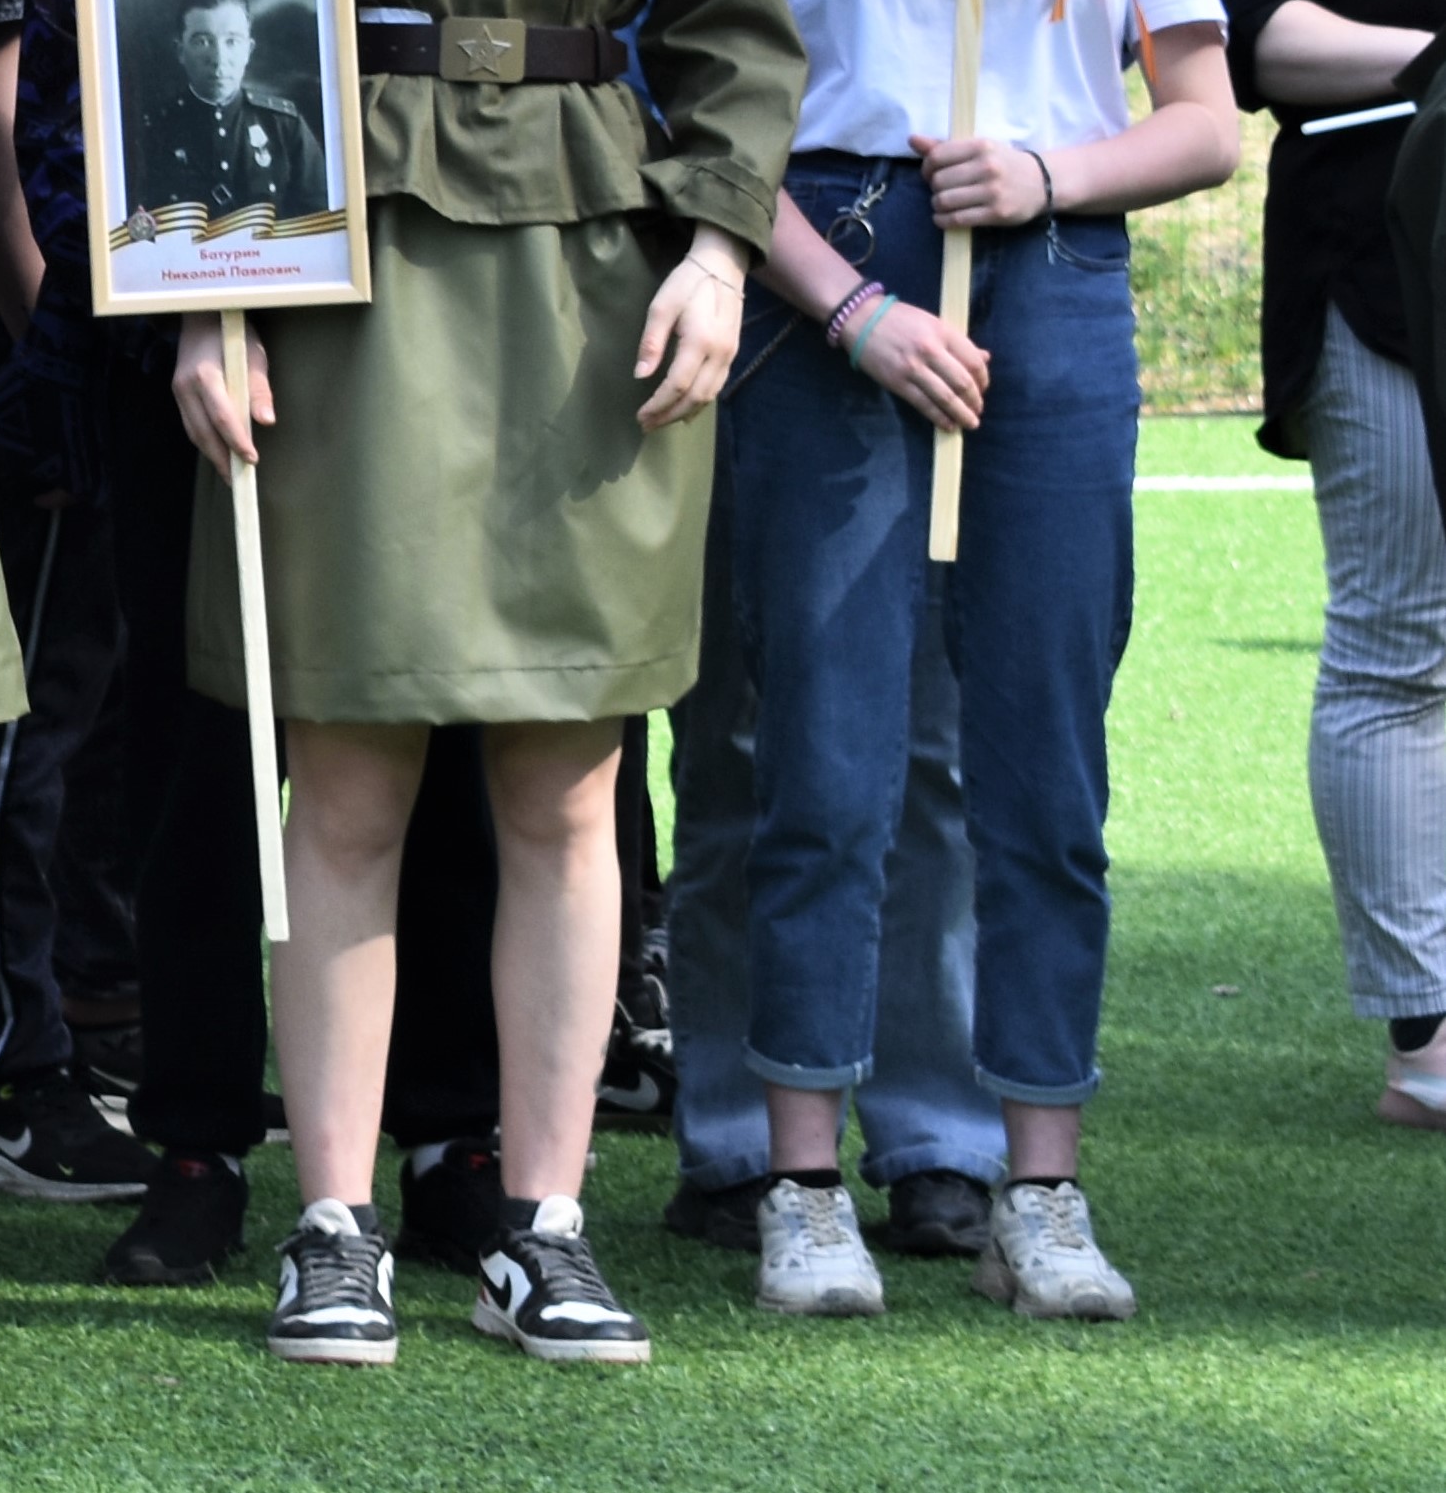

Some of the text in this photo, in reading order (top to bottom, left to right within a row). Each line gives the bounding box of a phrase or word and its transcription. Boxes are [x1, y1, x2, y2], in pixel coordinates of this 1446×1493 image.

[199, 248, 261, 263] Батурин
[161, 264, 302, 282] Николай Павлович
